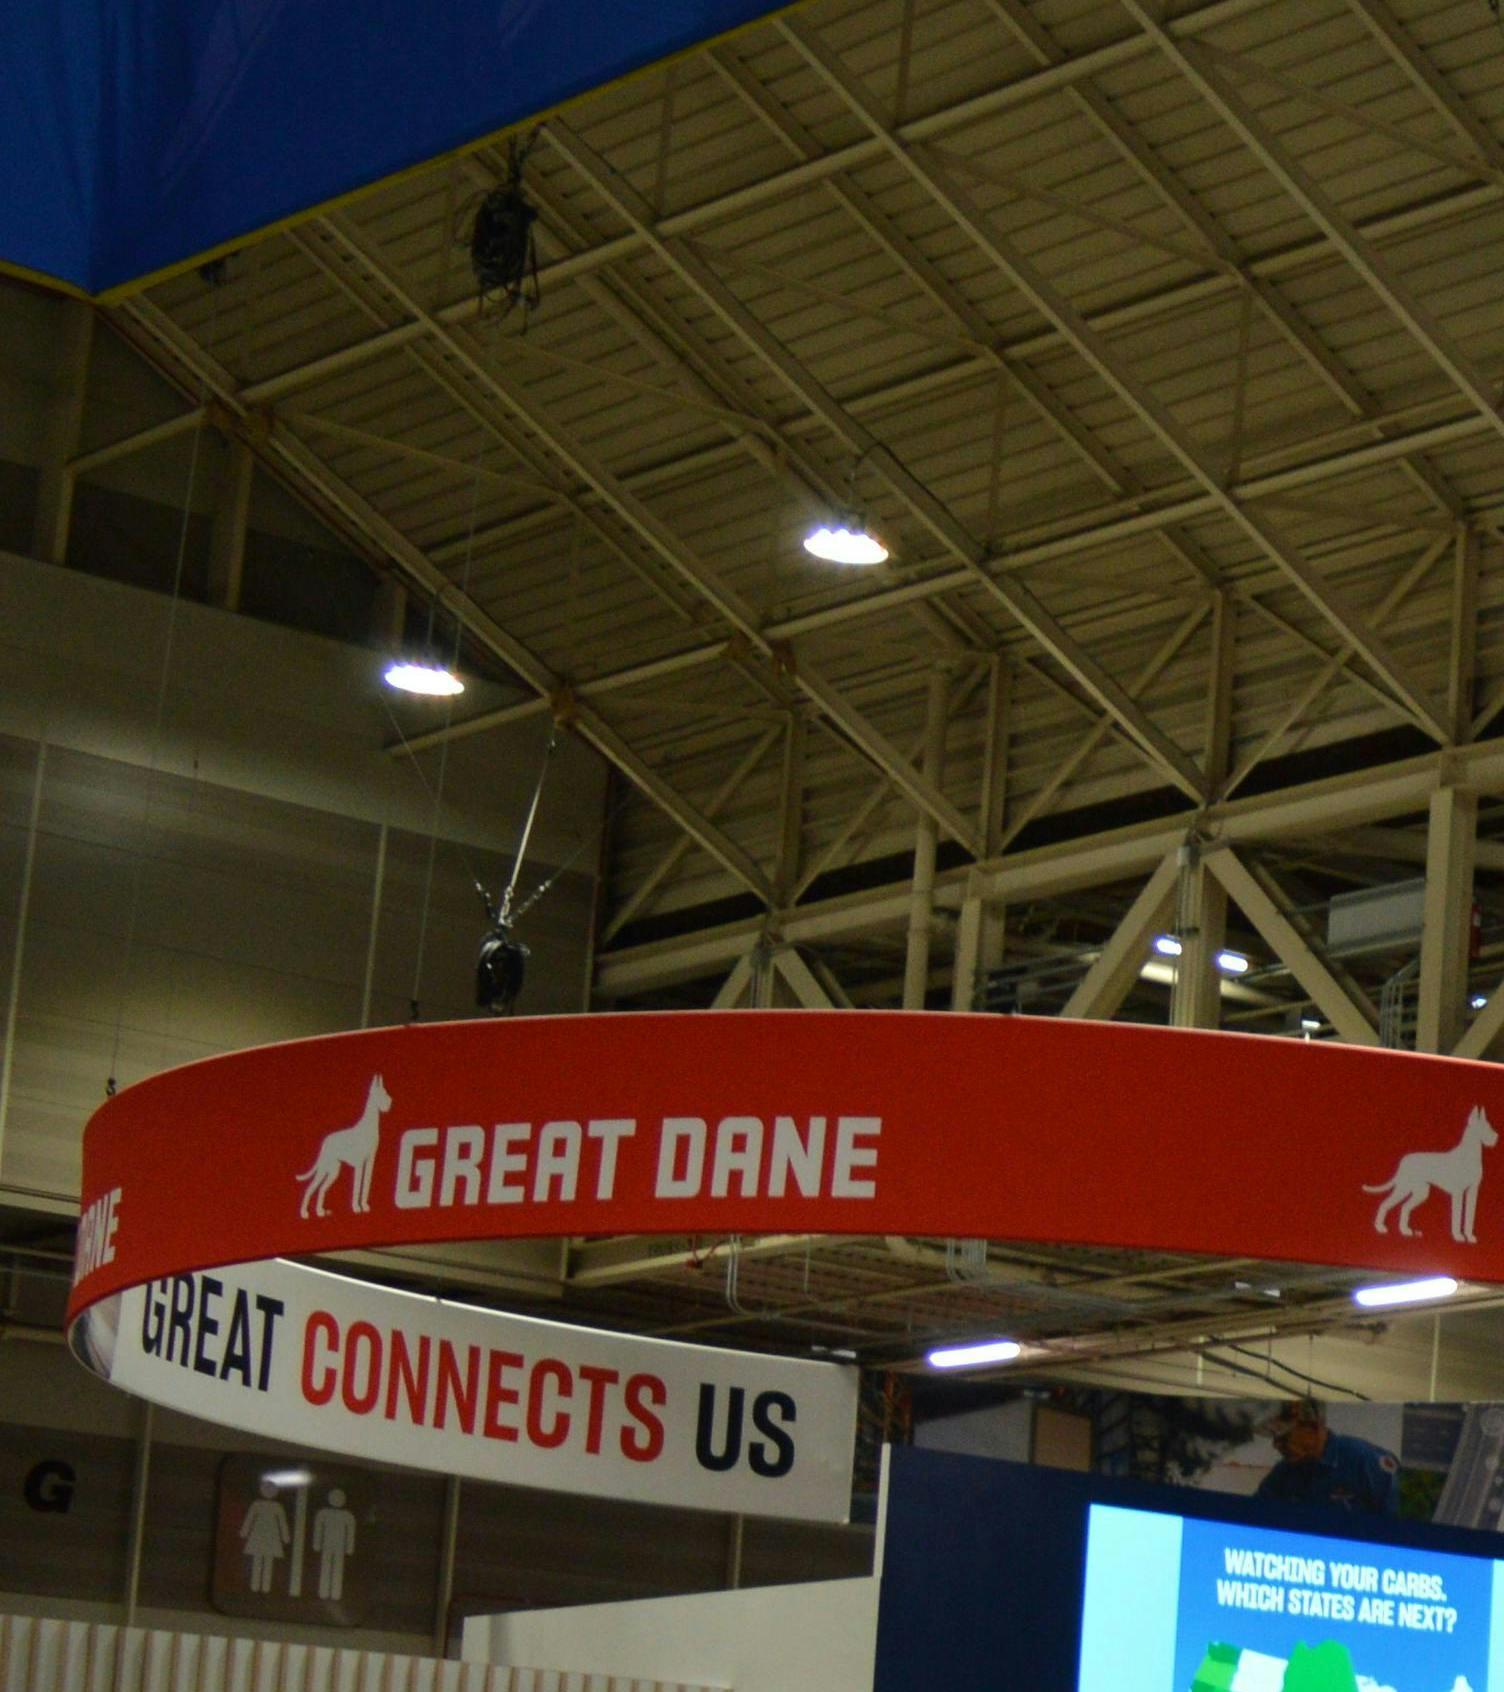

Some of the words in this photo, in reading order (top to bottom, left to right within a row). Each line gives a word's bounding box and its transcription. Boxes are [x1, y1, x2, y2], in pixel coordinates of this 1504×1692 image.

[394, 1119, 636, 1211] GREAT
[655, 1116, 884, 1200] DANE
[141, 1272, 285, 1392] GREAT
[301, 1310, 668, 1463] CONNECTS
[695, 1382, 797, 1478] US
[1217, 1579, 1285, 1613] WHICH
[1288, 1588, 1355, 1621] STATES
[1358, 1598, 1394, 1626] ARE
[1398, 1601, 1458, 1633] NEXT?
[1224, 1547, 1326, 1585] WATCHING
[1329, 1562, 1379, 1592] YOUR
[1382, 1569, 1448, 1601] CARBS.
